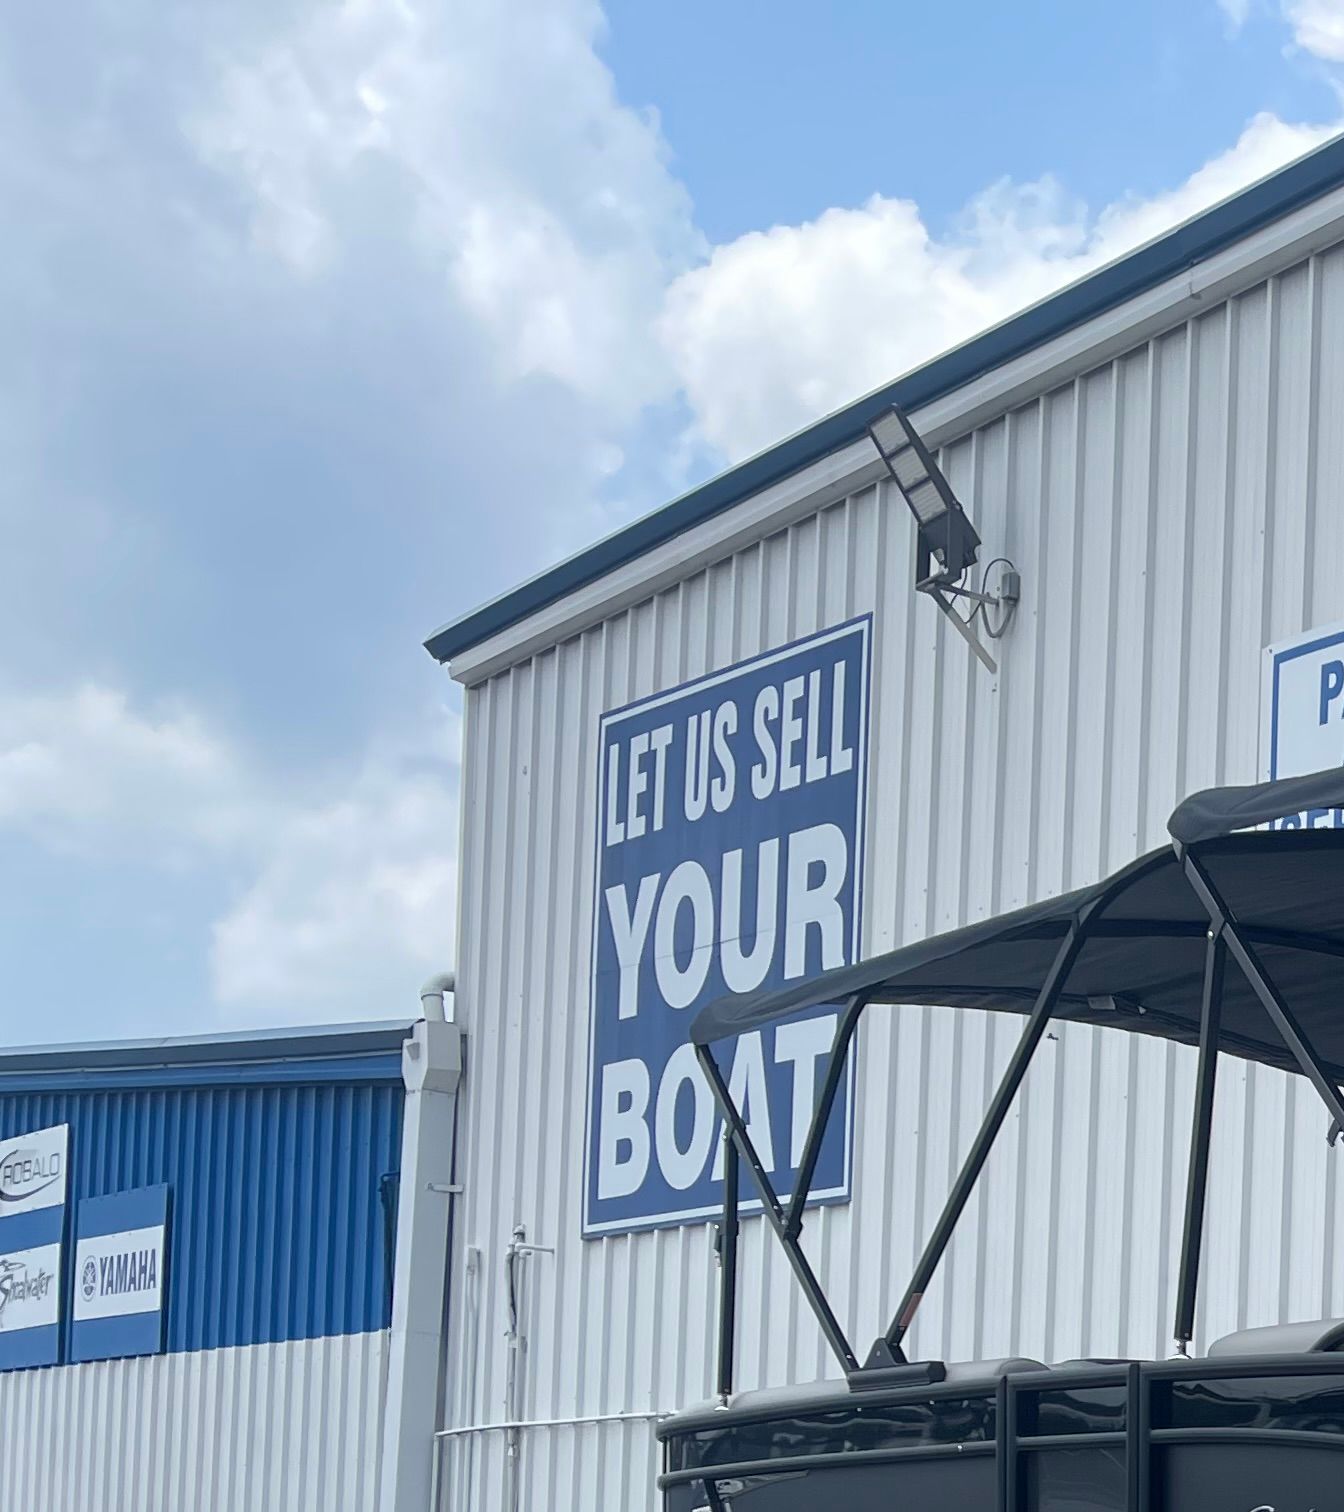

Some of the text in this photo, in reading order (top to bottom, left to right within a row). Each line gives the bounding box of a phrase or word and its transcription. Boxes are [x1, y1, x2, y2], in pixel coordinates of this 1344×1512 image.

[606, 660, 853, 847] LET US SELL
[605, 823, 848, 1020] YOUR
[597, 1013, 837, 1200] BOAT
[99, 1248, 157, 1297] YAMAHA
